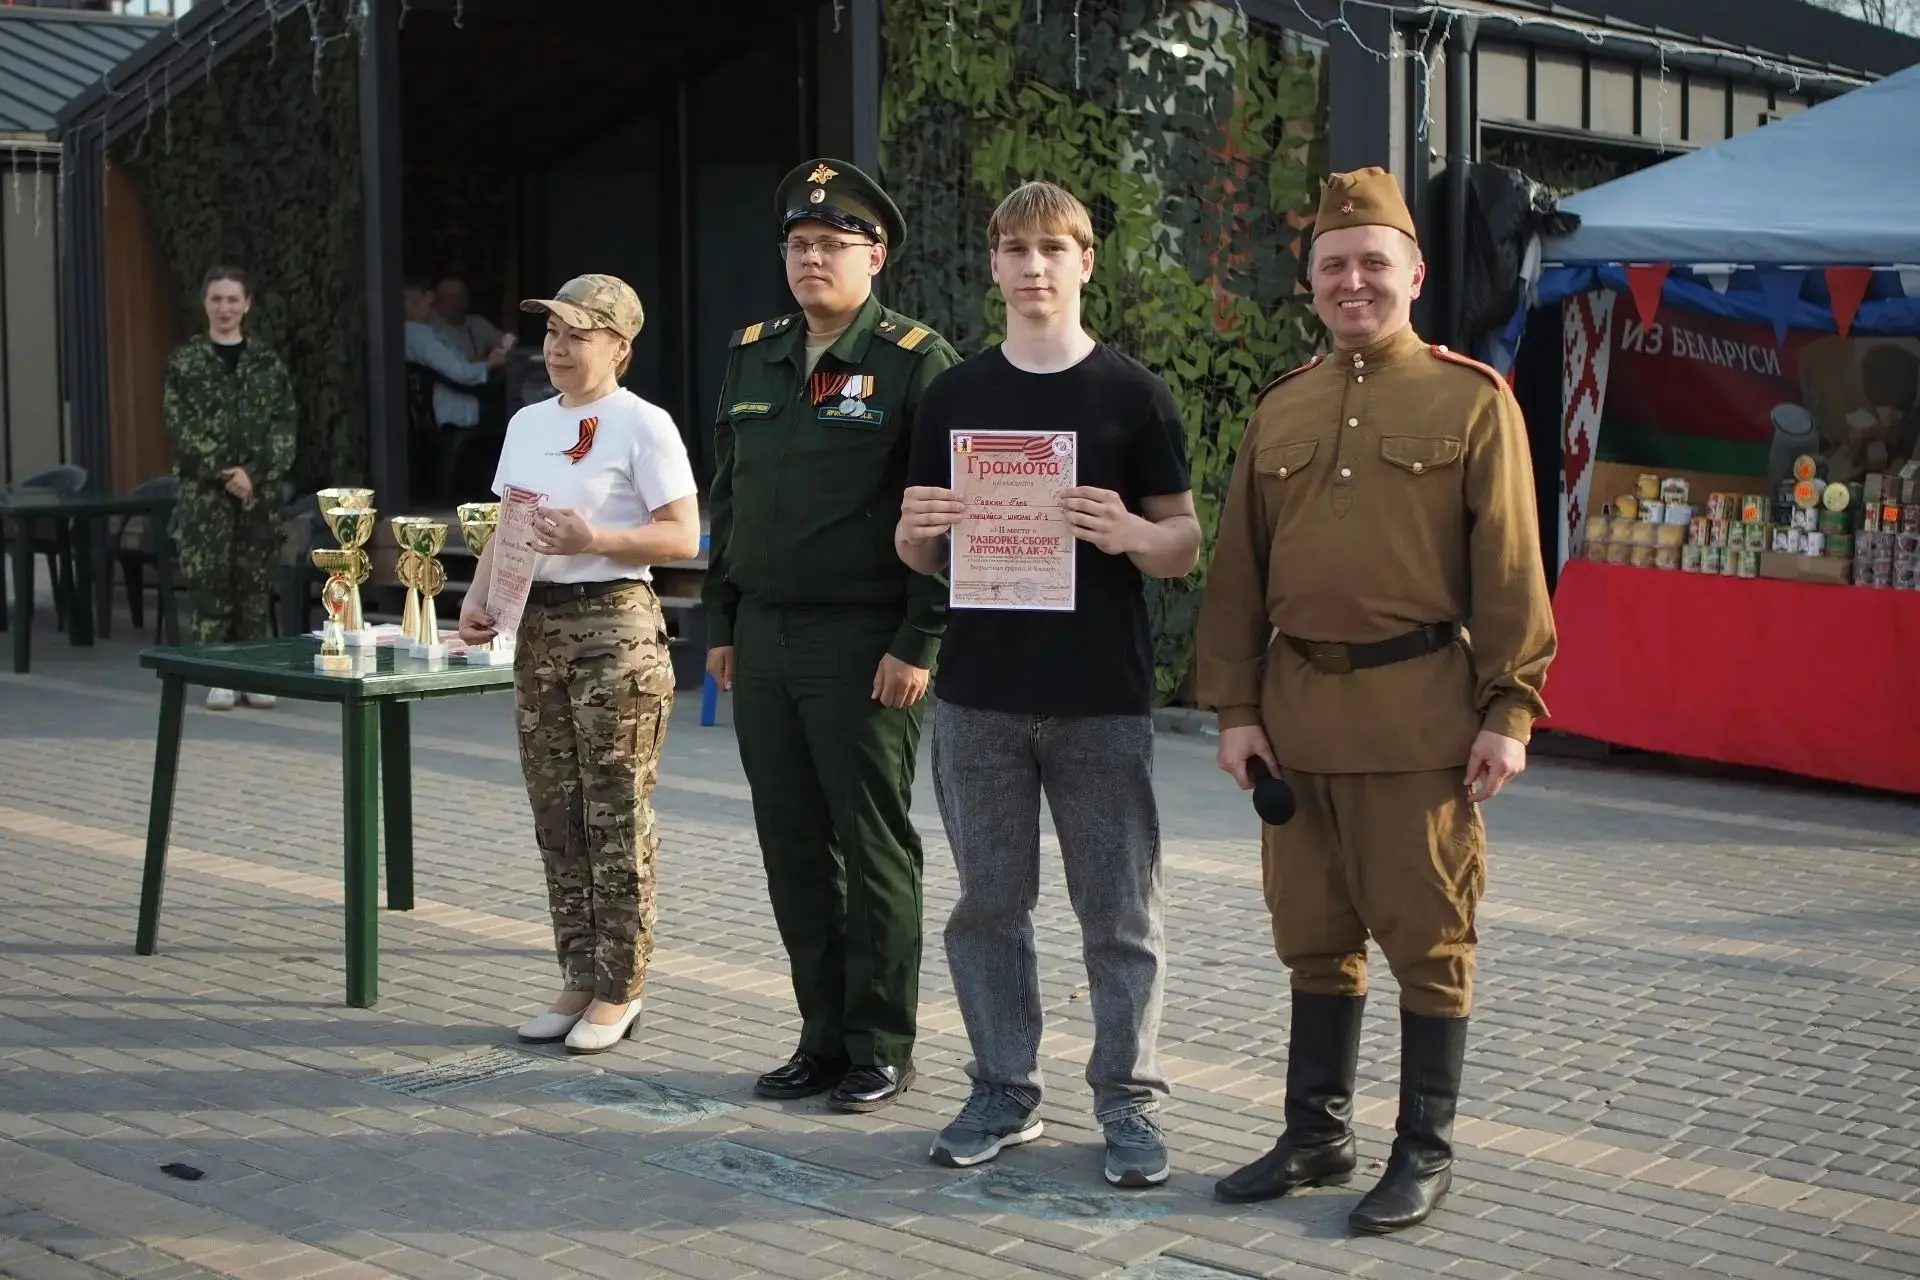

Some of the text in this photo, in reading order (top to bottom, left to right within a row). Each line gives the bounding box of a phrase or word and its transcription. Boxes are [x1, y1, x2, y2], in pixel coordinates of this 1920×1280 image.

[1621, 318, 1781, 376] ИЗ БЕЛАРУСИ
[967, 455, 1060, 479] Грамота
[969, 545, 1023, 554] АВТОМАТА
